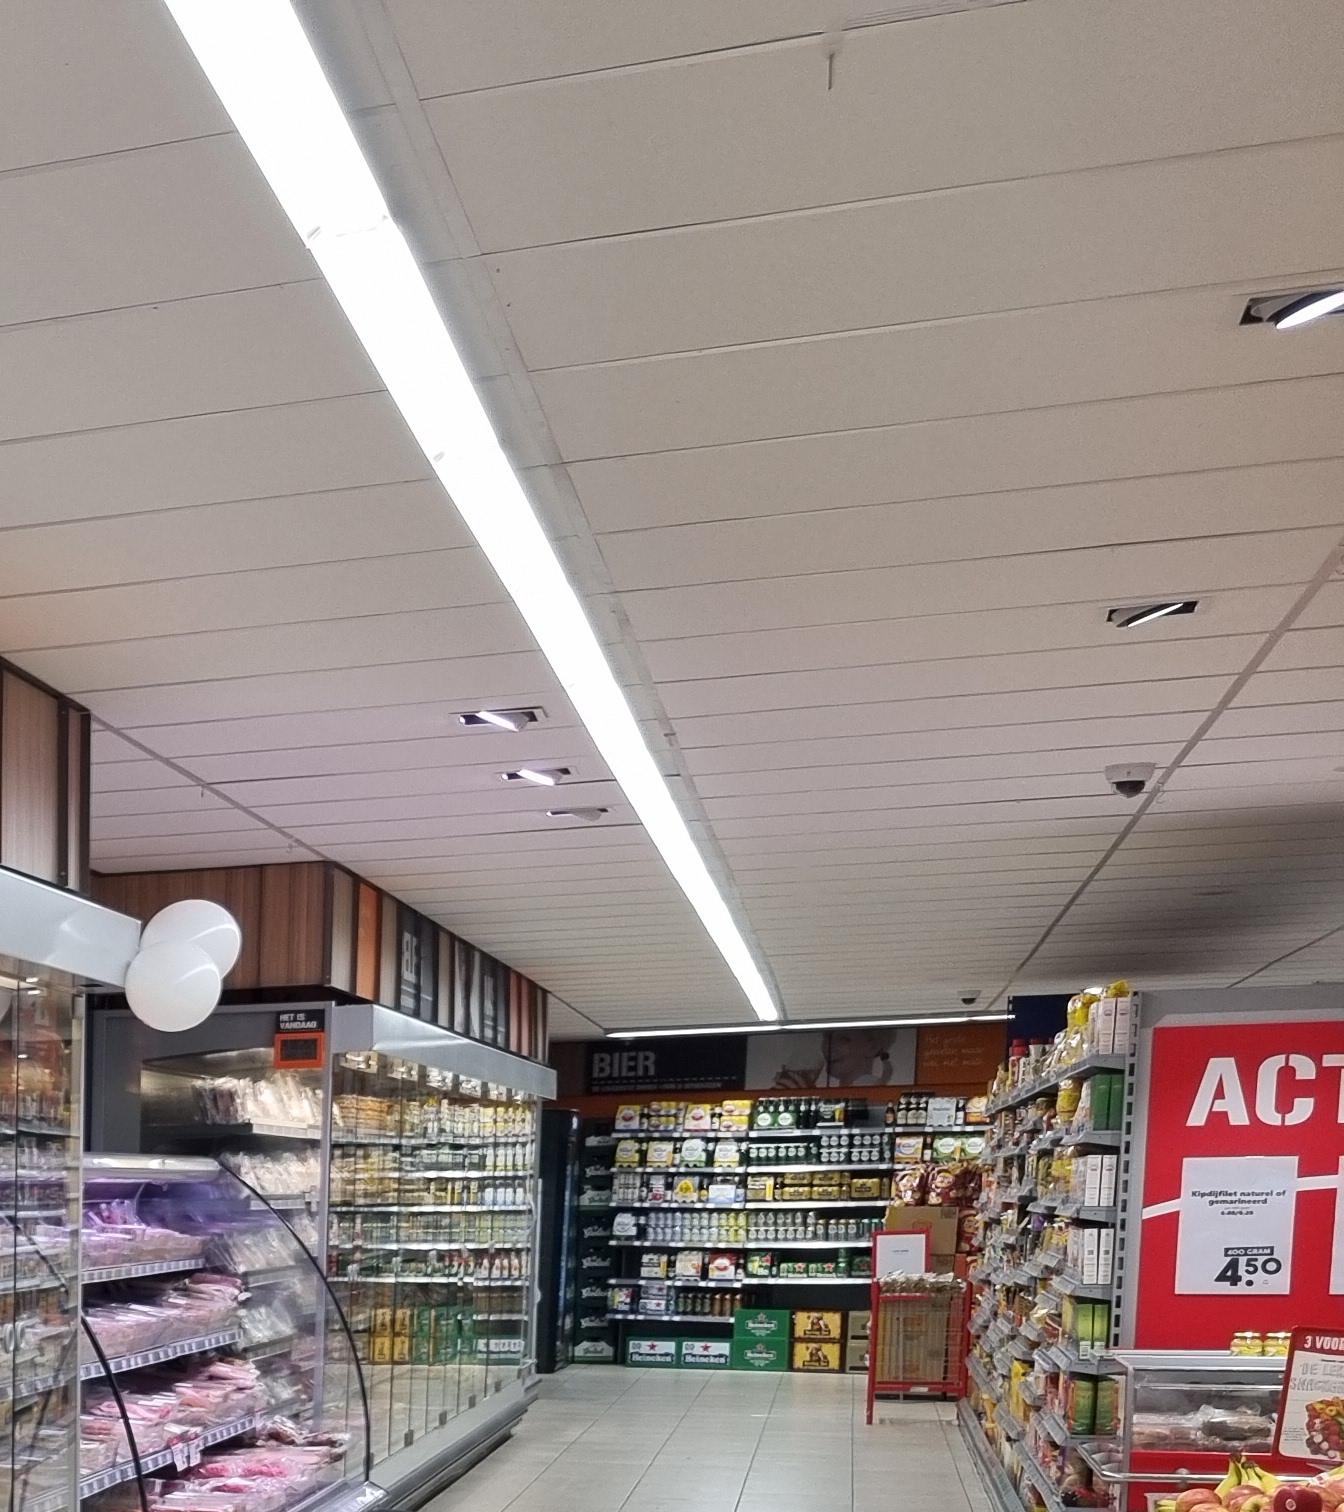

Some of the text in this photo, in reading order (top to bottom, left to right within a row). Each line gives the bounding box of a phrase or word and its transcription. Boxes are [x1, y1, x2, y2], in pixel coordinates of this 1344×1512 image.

[592, 1051, 656, 1078] BIER
[1208, 1198, 1267, 1206] gemarineerd
[1304, 1336, 1313, 1348] 3
[631, 1353, 673, 1363] Heineken
[683, 1354, 727, 1364] Heineken
